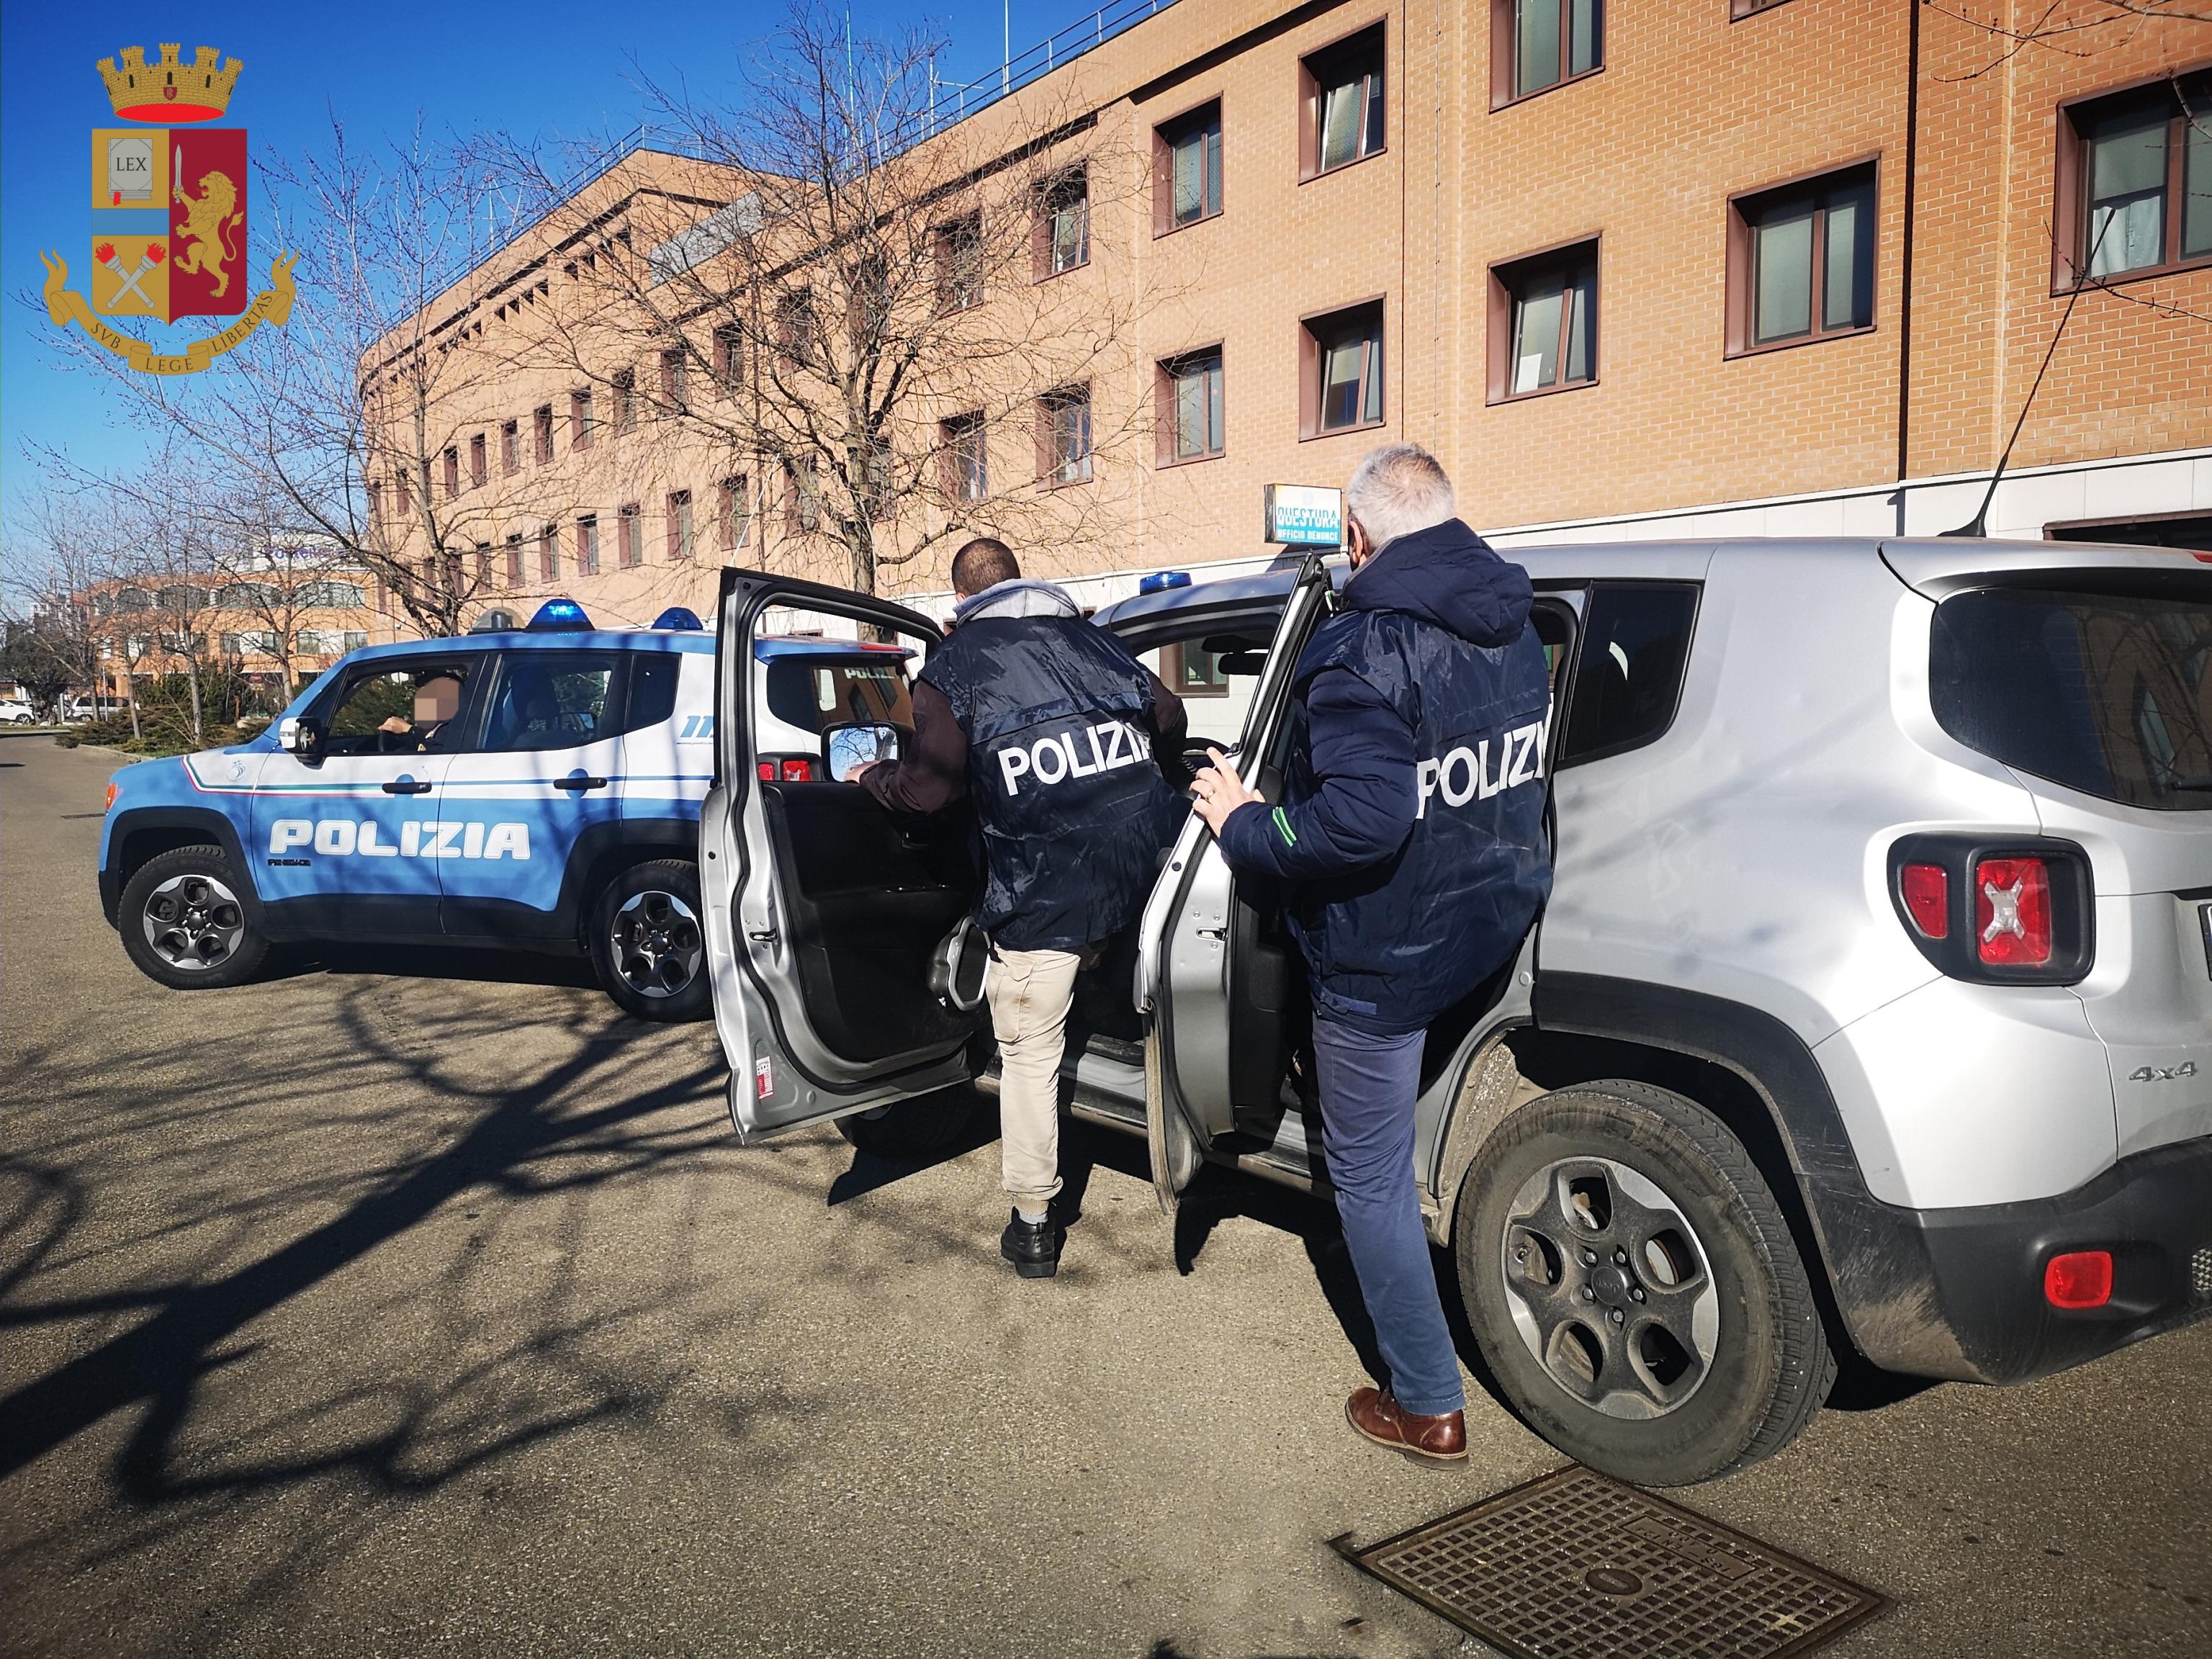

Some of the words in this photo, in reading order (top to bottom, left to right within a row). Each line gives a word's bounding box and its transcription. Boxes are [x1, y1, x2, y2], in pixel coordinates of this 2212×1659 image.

[1277, 506, 1339, 529] QUESTURA
[1277, 529, 1305, 539] UFFICIO
[1416, 720, 1544, 819] POLIZI
[269, 819, 531, 860] POLIZIA
[2128, 1061, 2198, 1082] 4x4
